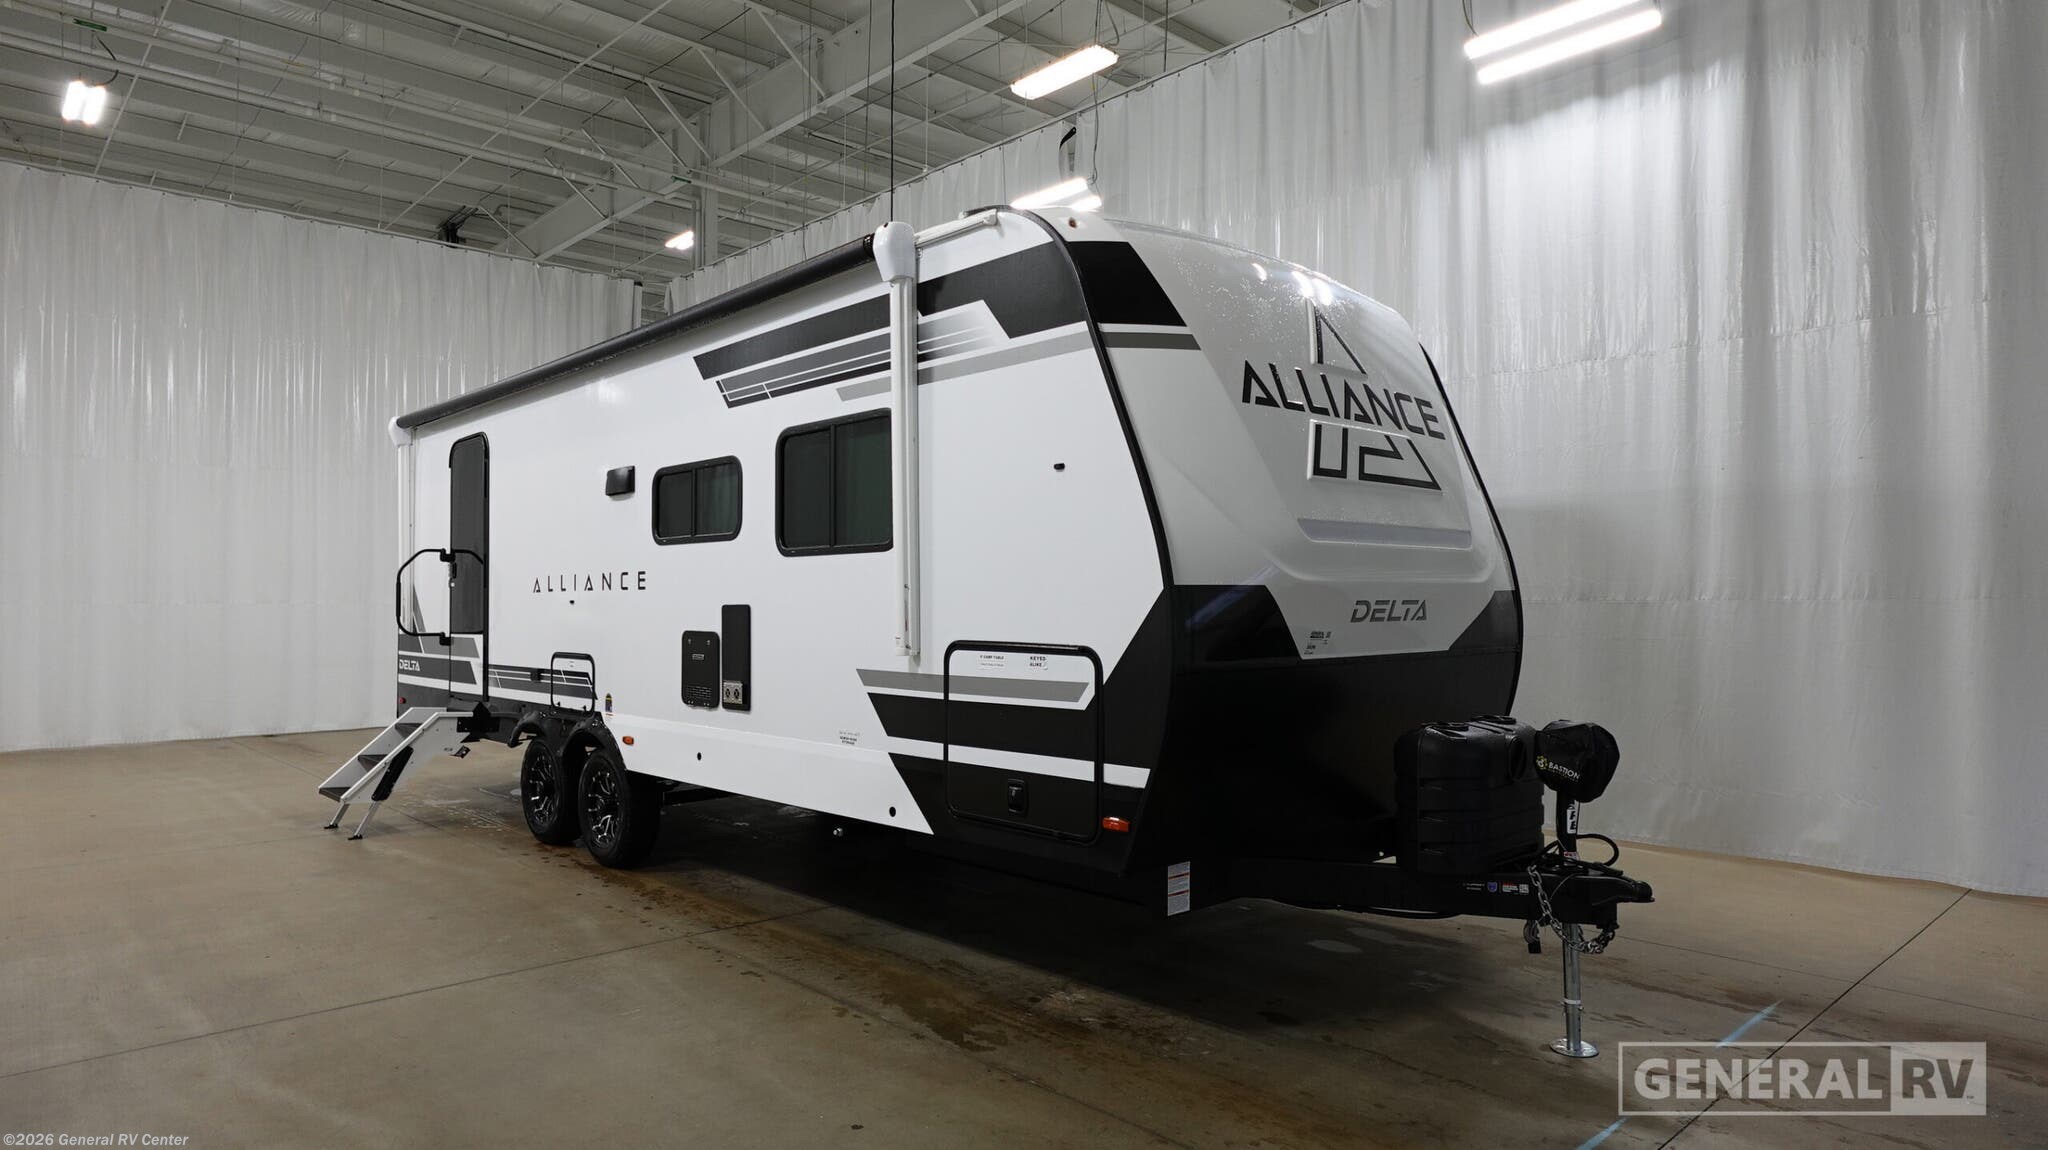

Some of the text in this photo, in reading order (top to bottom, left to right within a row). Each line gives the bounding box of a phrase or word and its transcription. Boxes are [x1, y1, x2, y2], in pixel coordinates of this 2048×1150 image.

[1241, 359, 1446, 440] ALLIANCE
[533, 571, 646, 593] ALLIANCE
[1350, 599, 1428, 623] DELTA
[399, 659, 420, 671] DELTA
[1548, 761, 1580, 780] BASTION
